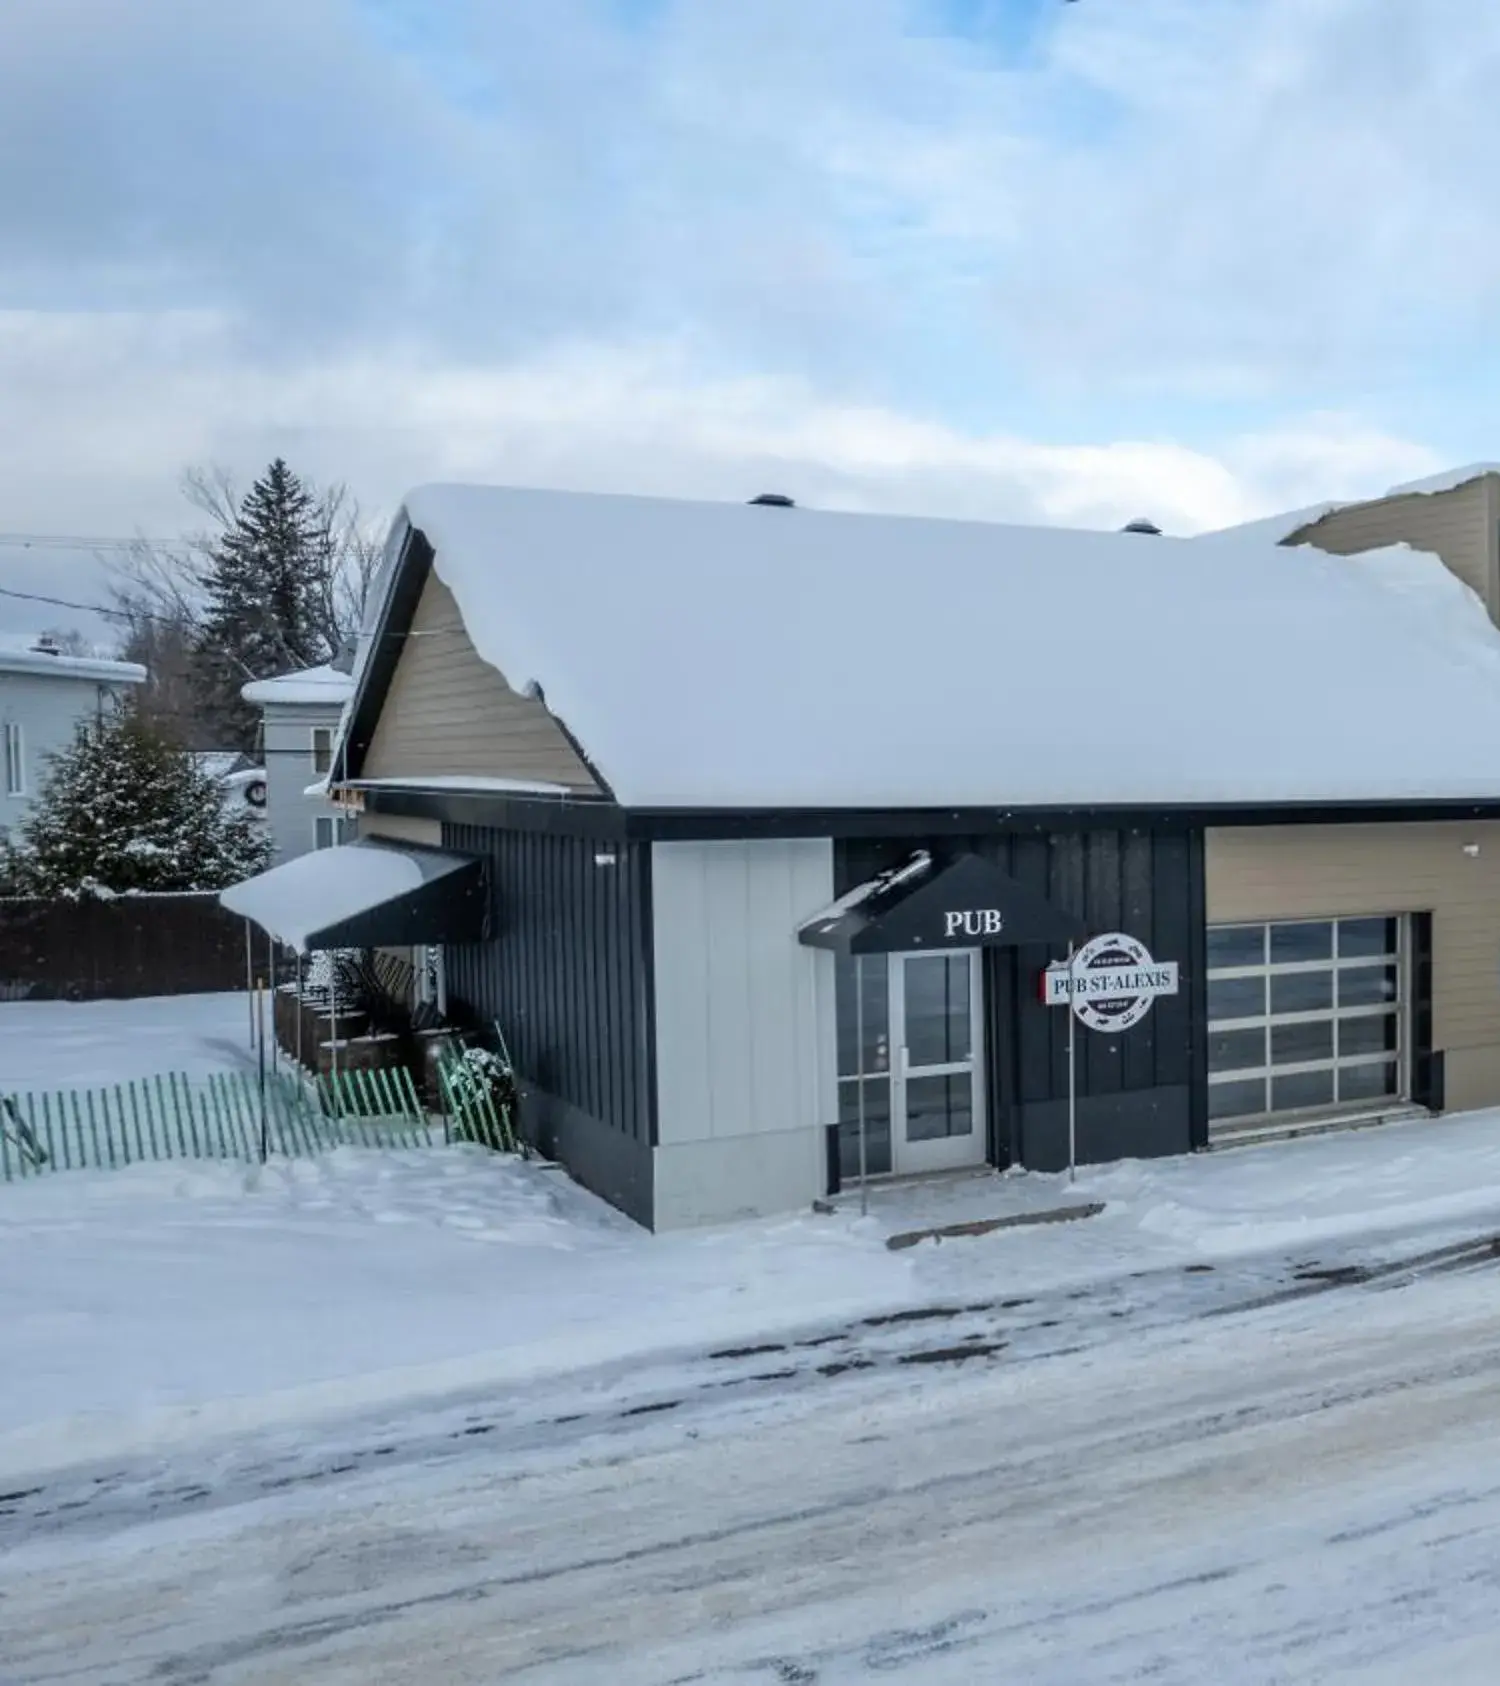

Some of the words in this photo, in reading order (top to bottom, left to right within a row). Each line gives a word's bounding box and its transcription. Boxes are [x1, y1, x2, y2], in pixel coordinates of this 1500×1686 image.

[944, 909, 1002, 937] PUB
[1053, 977, 1087, 994] PUB
[1089, 970, 1171, 994] ST-ALEXIS
